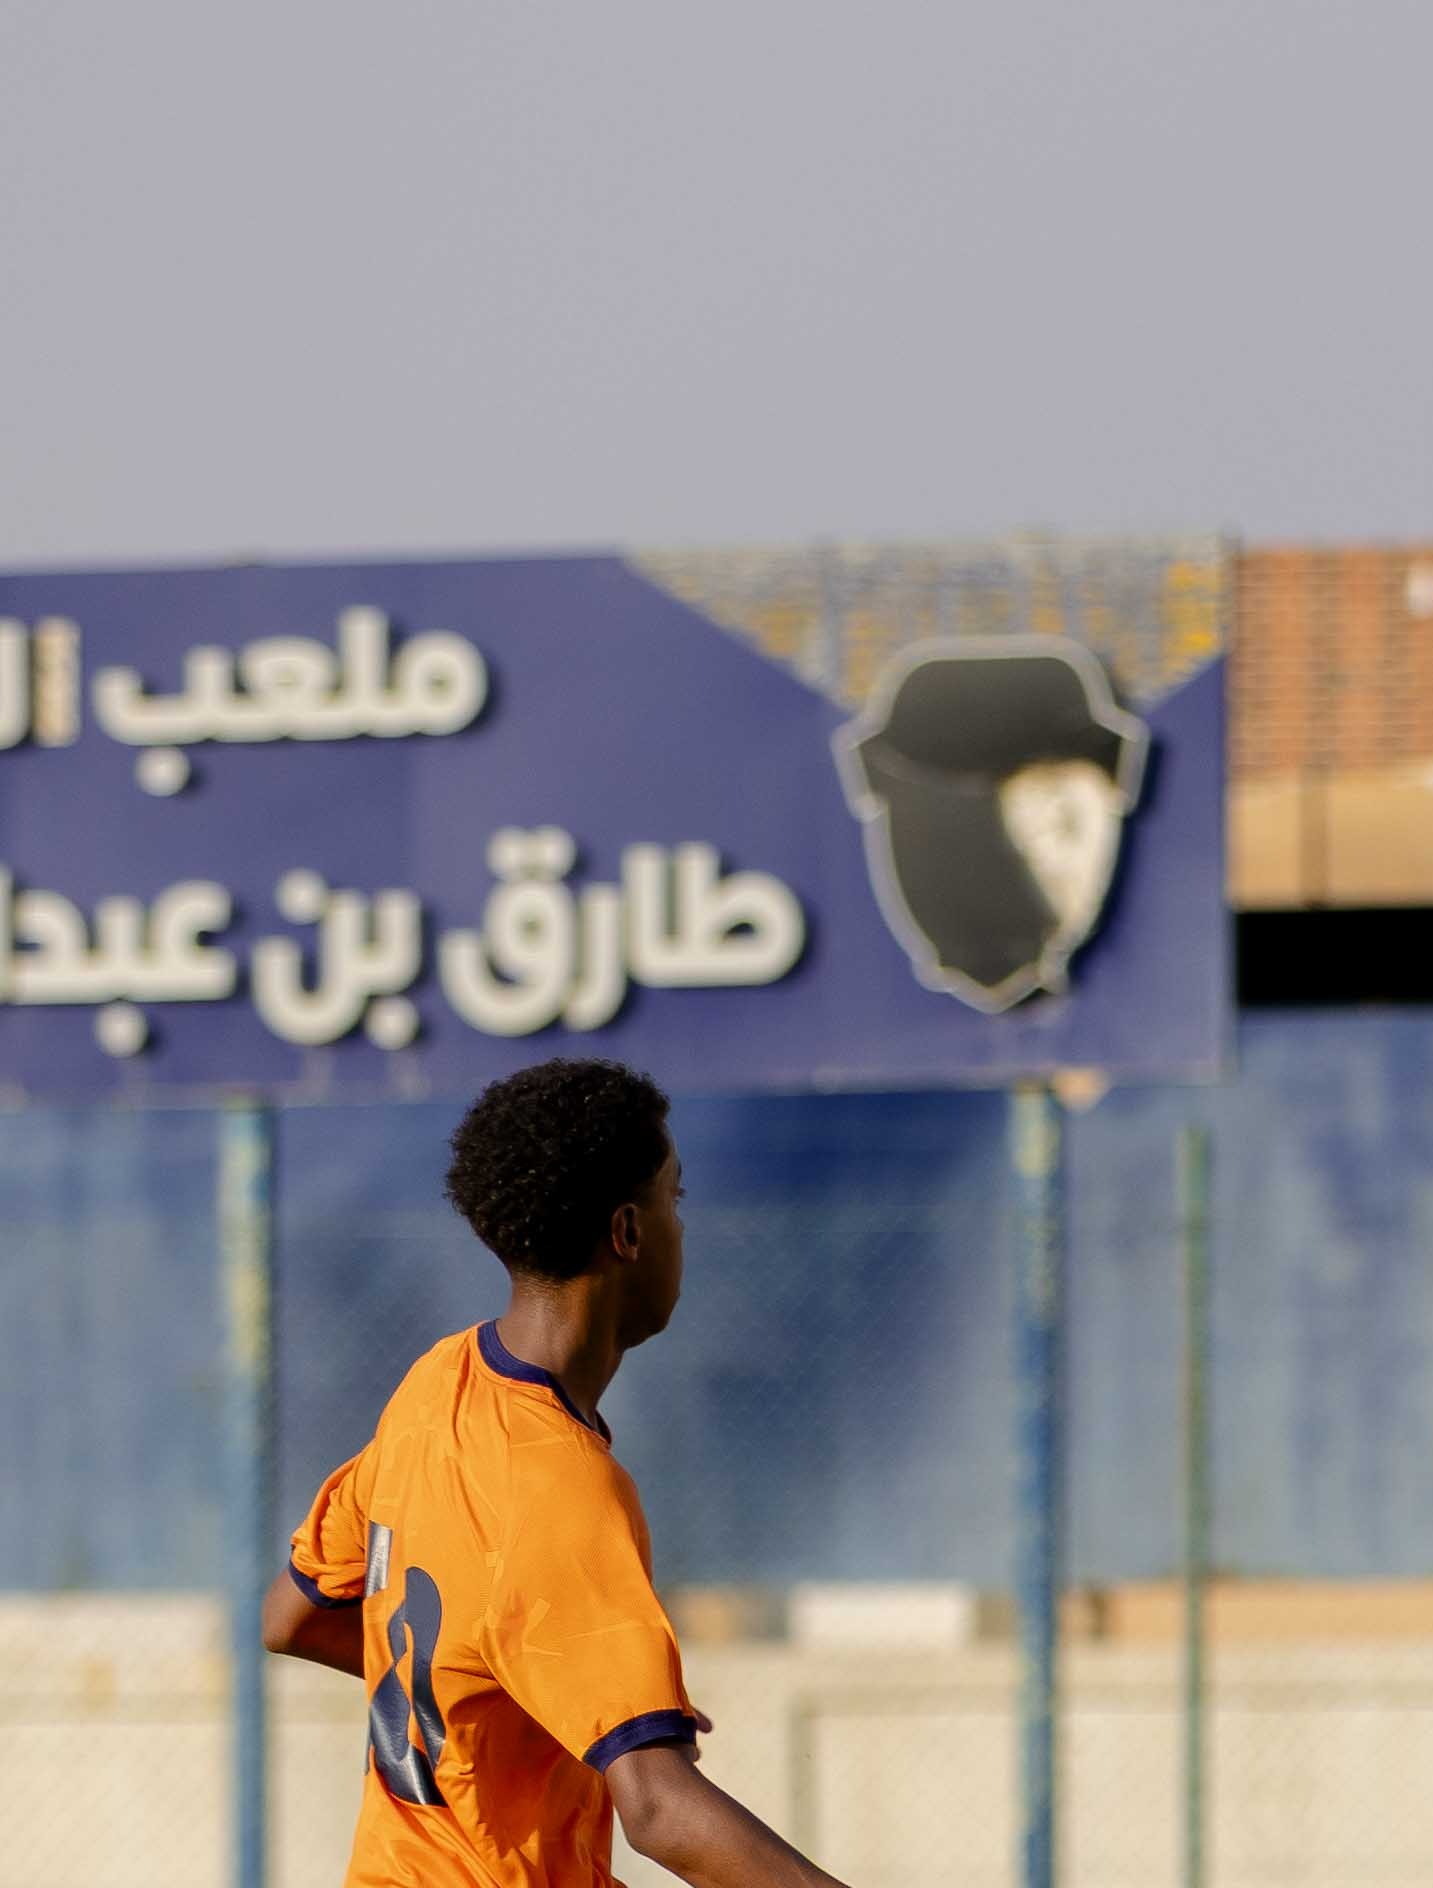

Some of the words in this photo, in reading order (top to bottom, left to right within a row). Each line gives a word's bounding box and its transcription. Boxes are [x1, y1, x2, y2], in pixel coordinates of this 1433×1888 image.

[93, 605, 488, 798] ملعب
[0, 862, 237, 1058] عبد
[252, 868, 423, 1050] بن
[438, 827, 805, 1037] طارق
